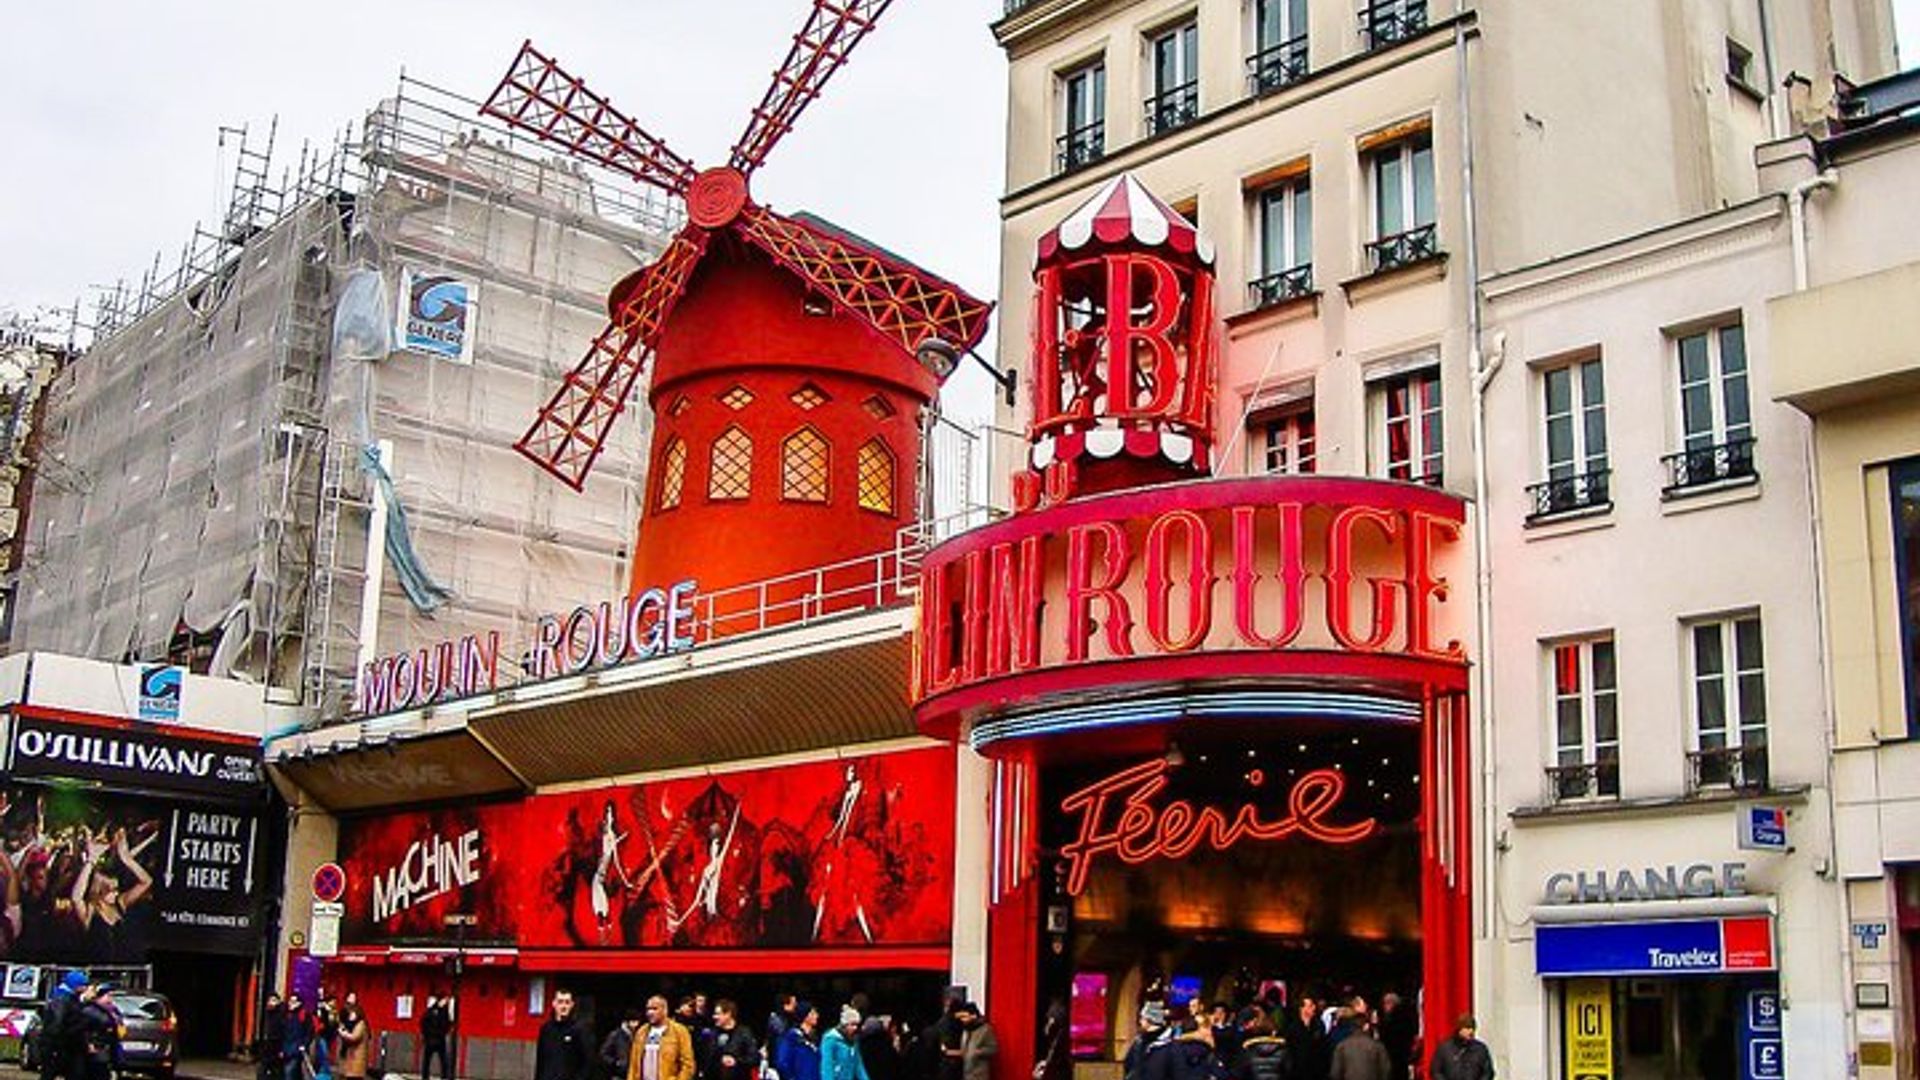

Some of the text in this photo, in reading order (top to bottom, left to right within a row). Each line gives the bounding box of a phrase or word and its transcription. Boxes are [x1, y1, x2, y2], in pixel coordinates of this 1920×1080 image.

[1066, 502, 1466, 663] ROUGE
[358, 579, 700, 714] MOULIN ROUGE
[18, 730, 215, 776] O'SULLIVANS
[188, 812, 241, 836] PARTY
[1061, 759, 1375, 896] Féerie
[181, 838, 241, 864] STARTS
[186, 866, 231, 890] HERE
[373, 829, 480, 923] MACHINE
[1545, 862, 1747, 903] CHANGE
[1648, 947, 1718, 968] Travelex
[1578, 1003, 1603, 1036] ICI
